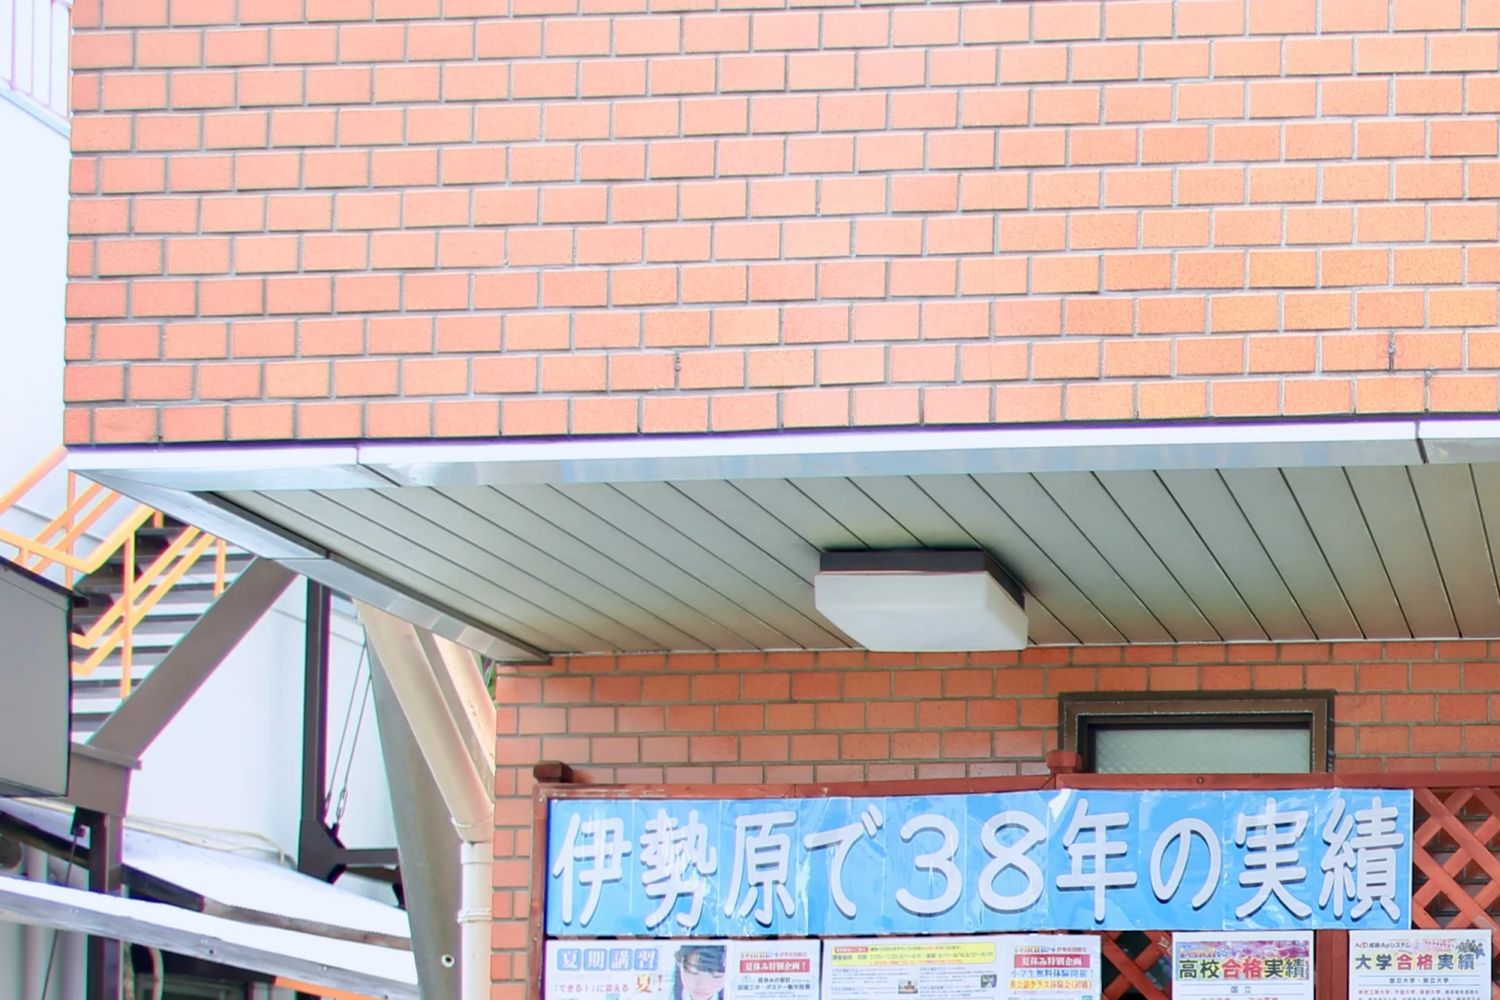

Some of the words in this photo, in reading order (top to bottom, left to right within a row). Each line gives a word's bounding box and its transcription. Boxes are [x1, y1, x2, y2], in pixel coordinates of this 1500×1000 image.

[552, 795, 1406, 929] 伊勢原で38年の実績
[562, 949, 656, 970] 夏期講習
[1179, 959, 1305, 979] 高校合格実績
[1355, 953, 1475, 970] 大学合格実績
